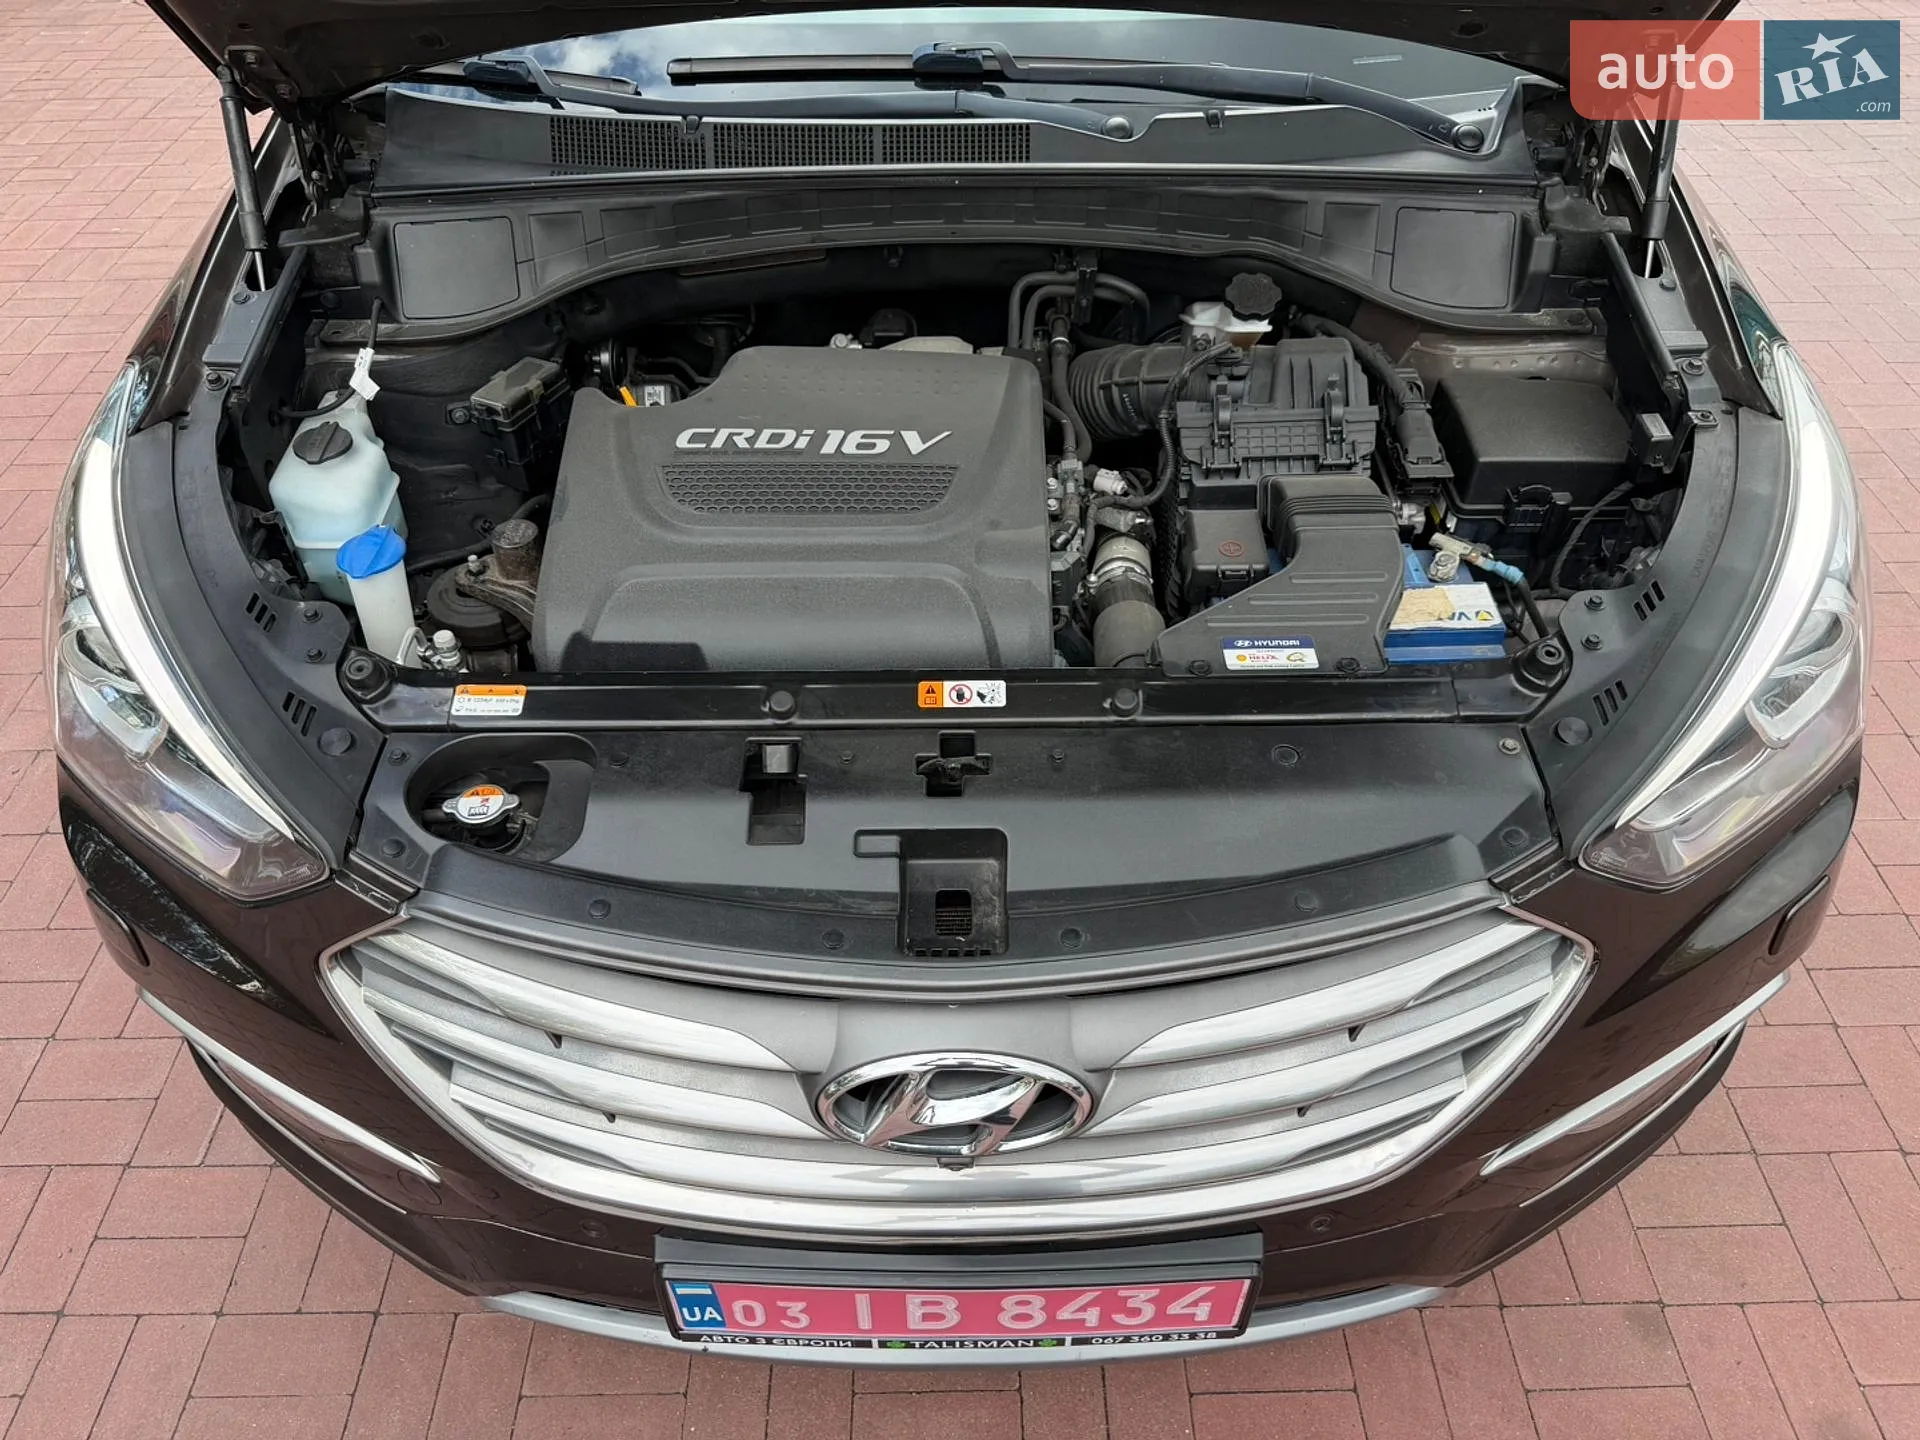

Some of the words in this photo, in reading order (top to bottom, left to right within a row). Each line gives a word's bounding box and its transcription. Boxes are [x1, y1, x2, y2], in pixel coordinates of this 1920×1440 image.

[675, 428, 816, 449] CRDi
[1254, 639, 1300, 647] HYUNDAI
[682, 1306, 723, 1322] UA
[731, 1299, 811, 1329] 03
[997, 1285, 1217, 1330] 8434
[700, 1334, 750, 1344] АВТО
[910, 1339, 1034, 1349] TALISMAN
